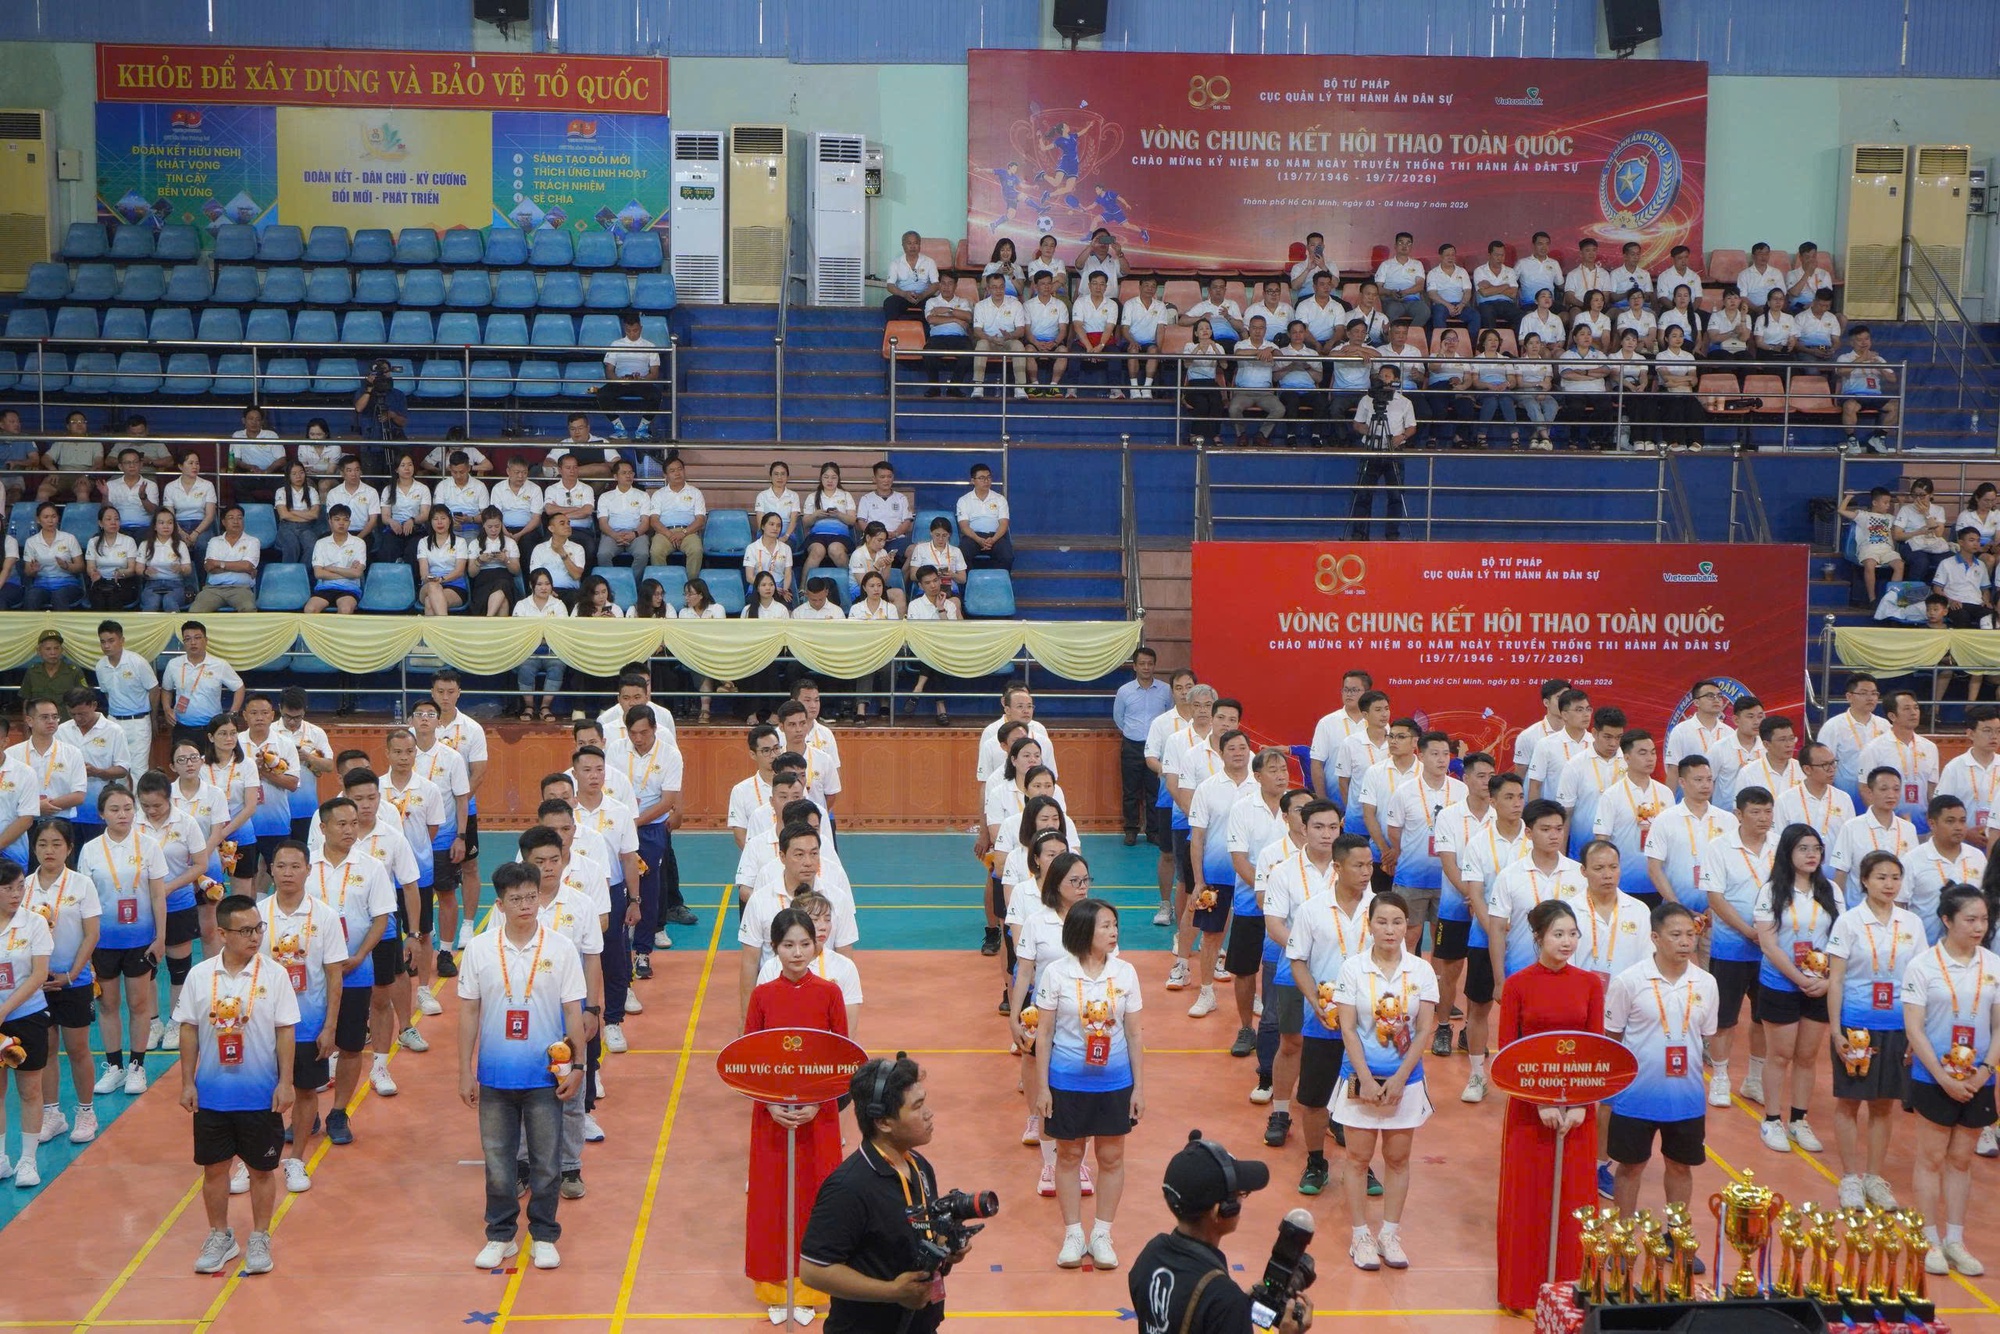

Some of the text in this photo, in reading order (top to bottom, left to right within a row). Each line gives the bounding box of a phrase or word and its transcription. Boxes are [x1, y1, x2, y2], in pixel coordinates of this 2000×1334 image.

[118, 54, 648, 103] KHỎE ĐỂ XÂY DỰNG VÀ BẢO VỆ TỔ QUỐC
[1324, 78, 1390, 90] BỘ TƯ PHÁP
[1260, 91, 1454, 105] CỤC QUẢN LÝ THI HÀNH ÁN DÂN SỰ
[1495, 97, 1543, 105] Vietcombank
[1140, 124, 1574, 158] VÒNG CHUNG KẾT HỘI THAO TOÀN QUỐC
[167, 143, 185, 155] KẾT
[214, 147, 241, 159] NGHỊ
[156, 158, 220, 172] KHÁT VỌNG
[533, 153, 562, 163] SÁNG
[566, 155, 587, 165] TẠO
[610, 155, 630, 164] MỚI
[1132, 156, 1163, 165] CHÀO
[1170, 156, 1202, 166] MỪNG
[1230, 157, 1259, 169] NIỆM
[1266, 158, 1280, 167] 80
[1317, 157, 1347, 168] NGÀY
[1406, 158, 1444, 170] THỐNG
[1450, 161, 1470, 171] THI
[1477, 159, 1507, 171] HÀNH
[1514, 159, 1528, 171] ÁN
[1535, 160, 1558, 172] DÂN
[1564, 162, 1579, 174] SỰ
[166, 174, 185, 183] TIN
[533, 166, 565, 176] THÍCH
[593, 168, 616, 178] LINH
[618, 170, 647, 180] HOẠT
[1278, 172, 1437, 184] (19/7/1946 19/7/2026)
[534, 179, 605, 193] TRÁCH NHIỆM
[548, 195, 573, 204] CHIA
[1243, 198, 1267, 206] Thành
[1342, 199, 1363, 208] ngày
[1396, 200, 1420, 209] tháng
[1450, 201, 1469, 209] 2026
[1482, 557, 1542, 568] BỘ TƯ PHÁP
[1315, 554, 1366, 591] 80
[1424, 569, 1600, 582] CỤC QUẢN LÝ THI HÀNH ÁN DÂN SỰ
[1663, 574, 1718, 582] Vietcombank
[1278, 604, 1725, 638] VÒNG CHUNG KẾT HỘI THAO TOÀN QUỐC
[1270, 637, 1731, 652] CHÀO MỪNG KỶ NIỆM 80 NĂM NGÀY TRUYỀN THỐNG THI HÀNH ÁN DÂN SỰ
[1420, 654, 1584, 664] (19/7/1946 19/7/2026)
[1415, 678, 1432, 687] phố
[1463, 678, 1484, 686] Minh,
[1488, 679, 1508, 687] ngày
[725, 1060, 860, 1076] KHU VỰC CÁC THÀNH PHỐ
[1518, 1060, 1610, 1076] CỤC THI HÀNH ÁN
[1520, 1075, 1606, 1089] BỘ QUỐC PHÒNG
